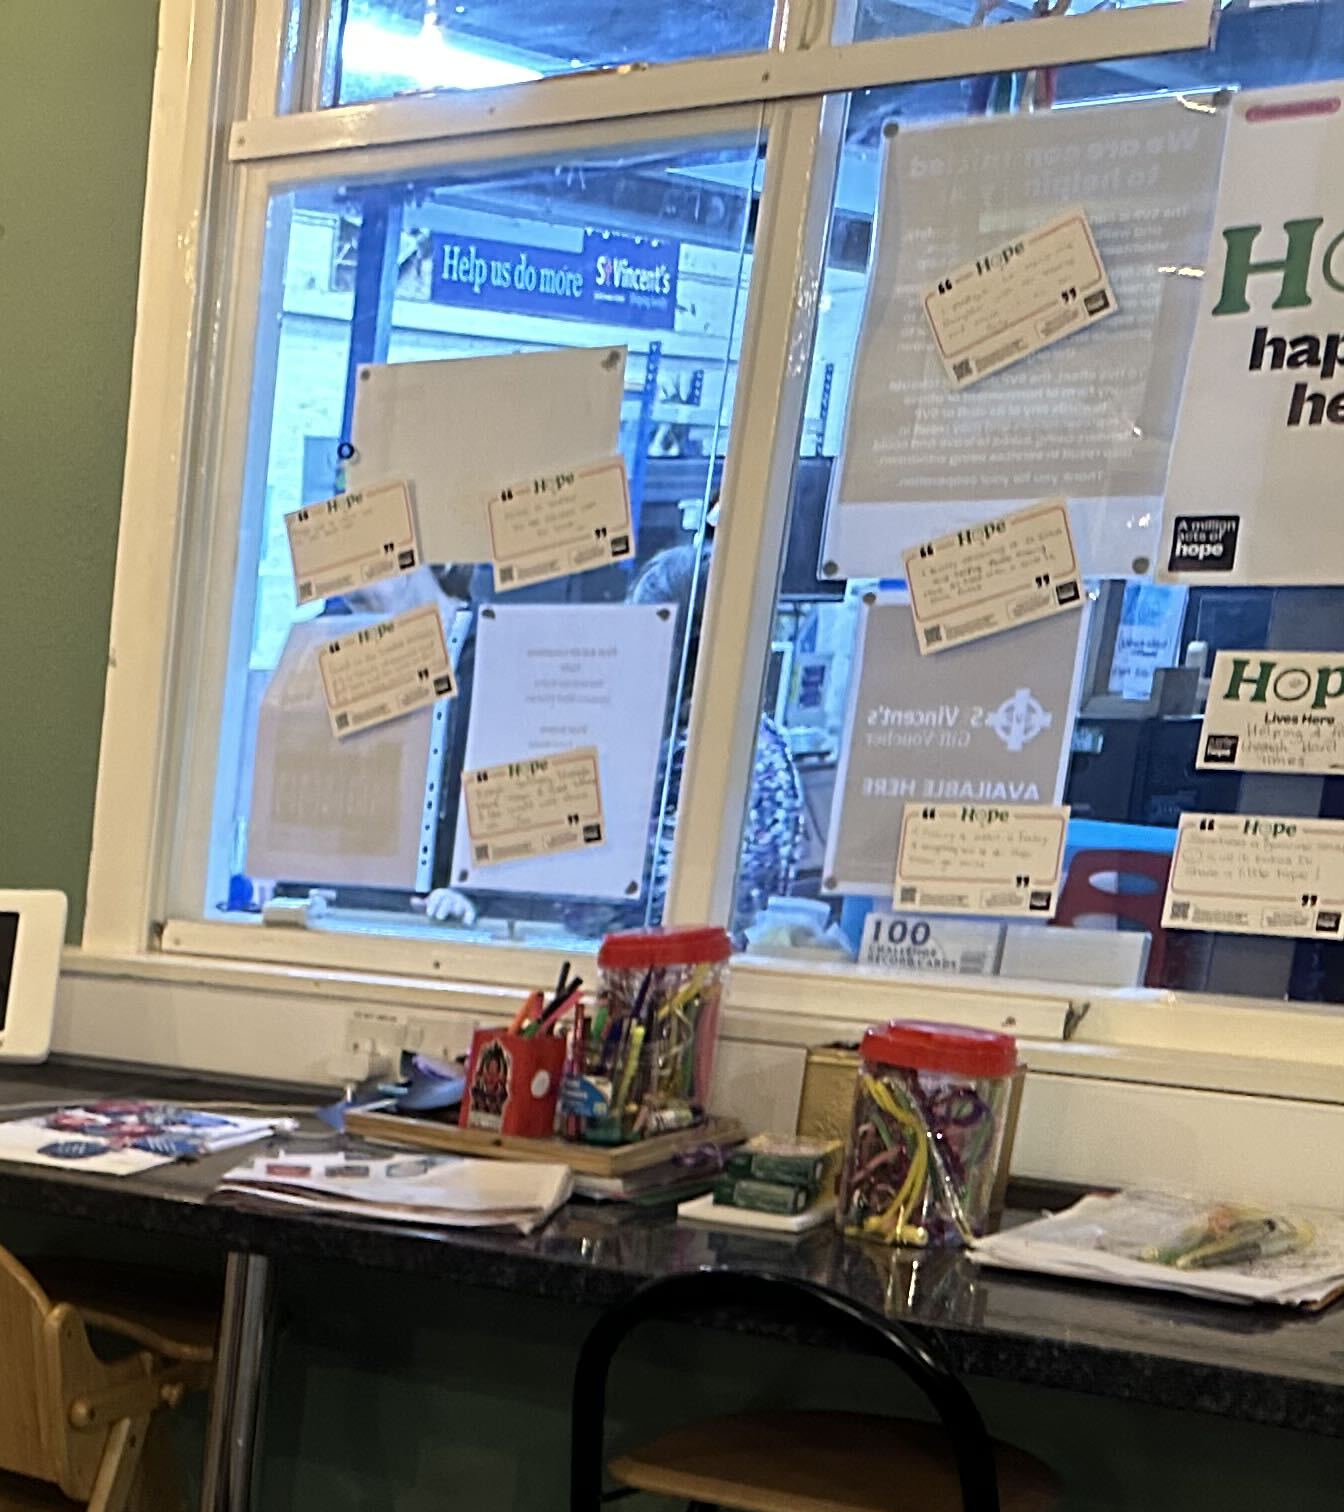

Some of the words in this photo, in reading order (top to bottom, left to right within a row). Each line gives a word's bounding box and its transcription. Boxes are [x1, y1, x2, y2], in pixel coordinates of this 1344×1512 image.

[441, 244, 487, 294] Help
[490, 259, 511, 289] us
[514, 251, 537, 291] do
[539, 265, 584, 297] more
[1191, 519, 1236, 533] million
[1175, 543, 1223, 560] hope
[1223, 658, 1344, 709] Hop
[1264, 712, 1298, 725] Lives
[1302, 713, 1334, 725] Here
[873, 920, 930, 946] 100
